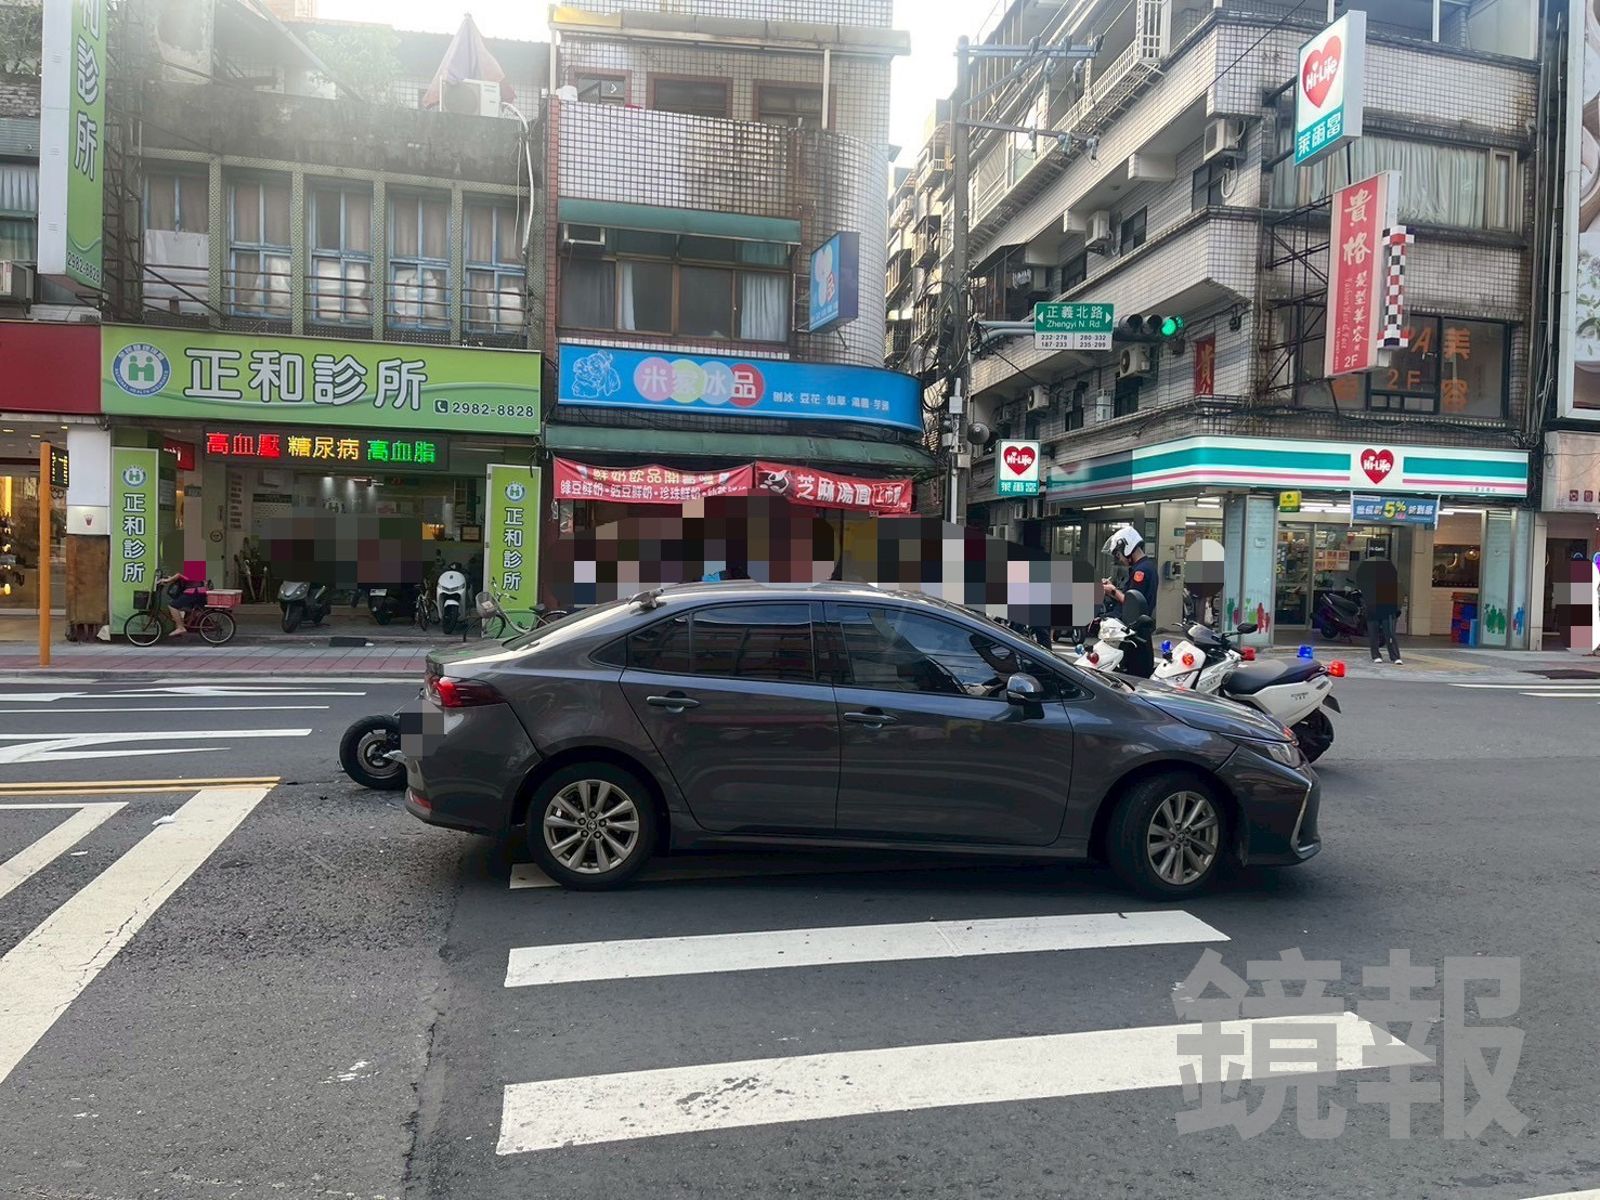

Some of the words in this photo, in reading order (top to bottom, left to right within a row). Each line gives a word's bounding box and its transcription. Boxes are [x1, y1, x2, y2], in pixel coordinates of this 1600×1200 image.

[1306, 56, 1338, 91] Hi-Life
[1298, 112, 1341, 157] 萊爾富
[67, 251, 101, 284] 2982-8828
[1046, 306, 1103, 319] 正義北路
[1047, 320, 1077, 329] Zhengyi
[1344, 354, 1358, 368] 2F
[184, 347, 428, 411] 正和診所
[642, 368, 757, 400] 米家冰品
[452, 400, 535, 419] 2982-8828
[207, 433, 281, 459] 高血壓
[288, 436, 360, 461] 糖尿病
[367, 440, 436, 463] 高血脂
[1007, 452, 1032, 466] Hi-Life
[1363, 456, 1391, 473] Hi-Life
[796, 474, 871, 505] 芝麻湯圓
[1384, 501, 1406, 519] 5%
[123, 493, 146, 583] 正和診所
[502, 507, 524, 591] 正和診所
